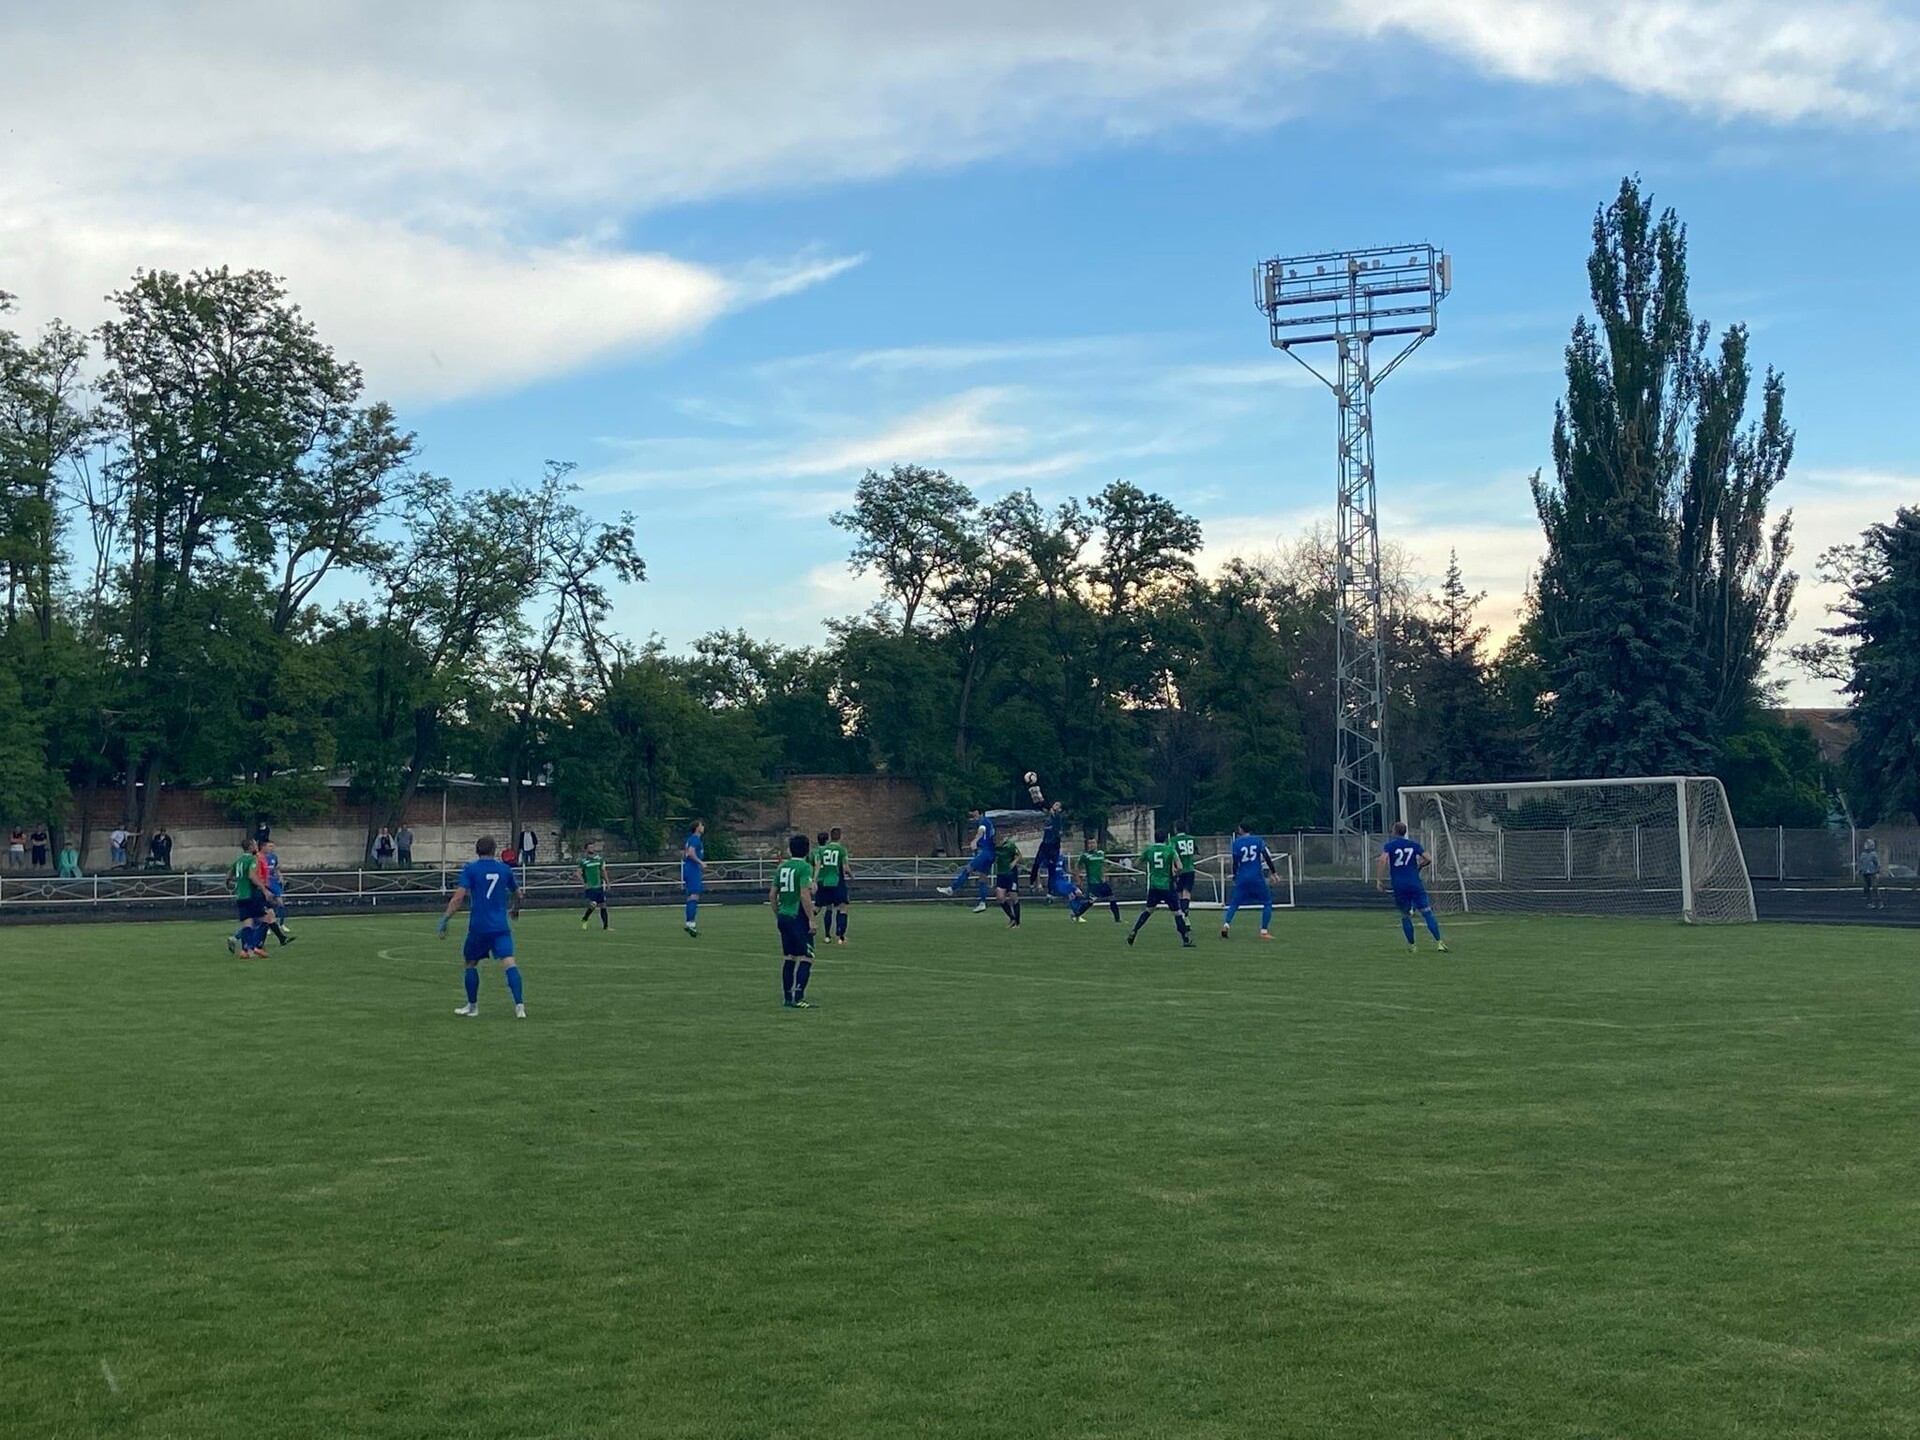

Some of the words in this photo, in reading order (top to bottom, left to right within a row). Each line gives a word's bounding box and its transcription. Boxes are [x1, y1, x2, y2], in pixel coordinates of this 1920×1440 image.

[1178, 840, 1194, 855] 98
[1241, 845, 1257, 862] 25
[823, 850, 839, 866] 20
[1154, 852, 1164, 869] 5
[1394, 848, 1414, 866] 27
[486, 873, 500, 899] 7
[780, 868, 795, 892] 91
